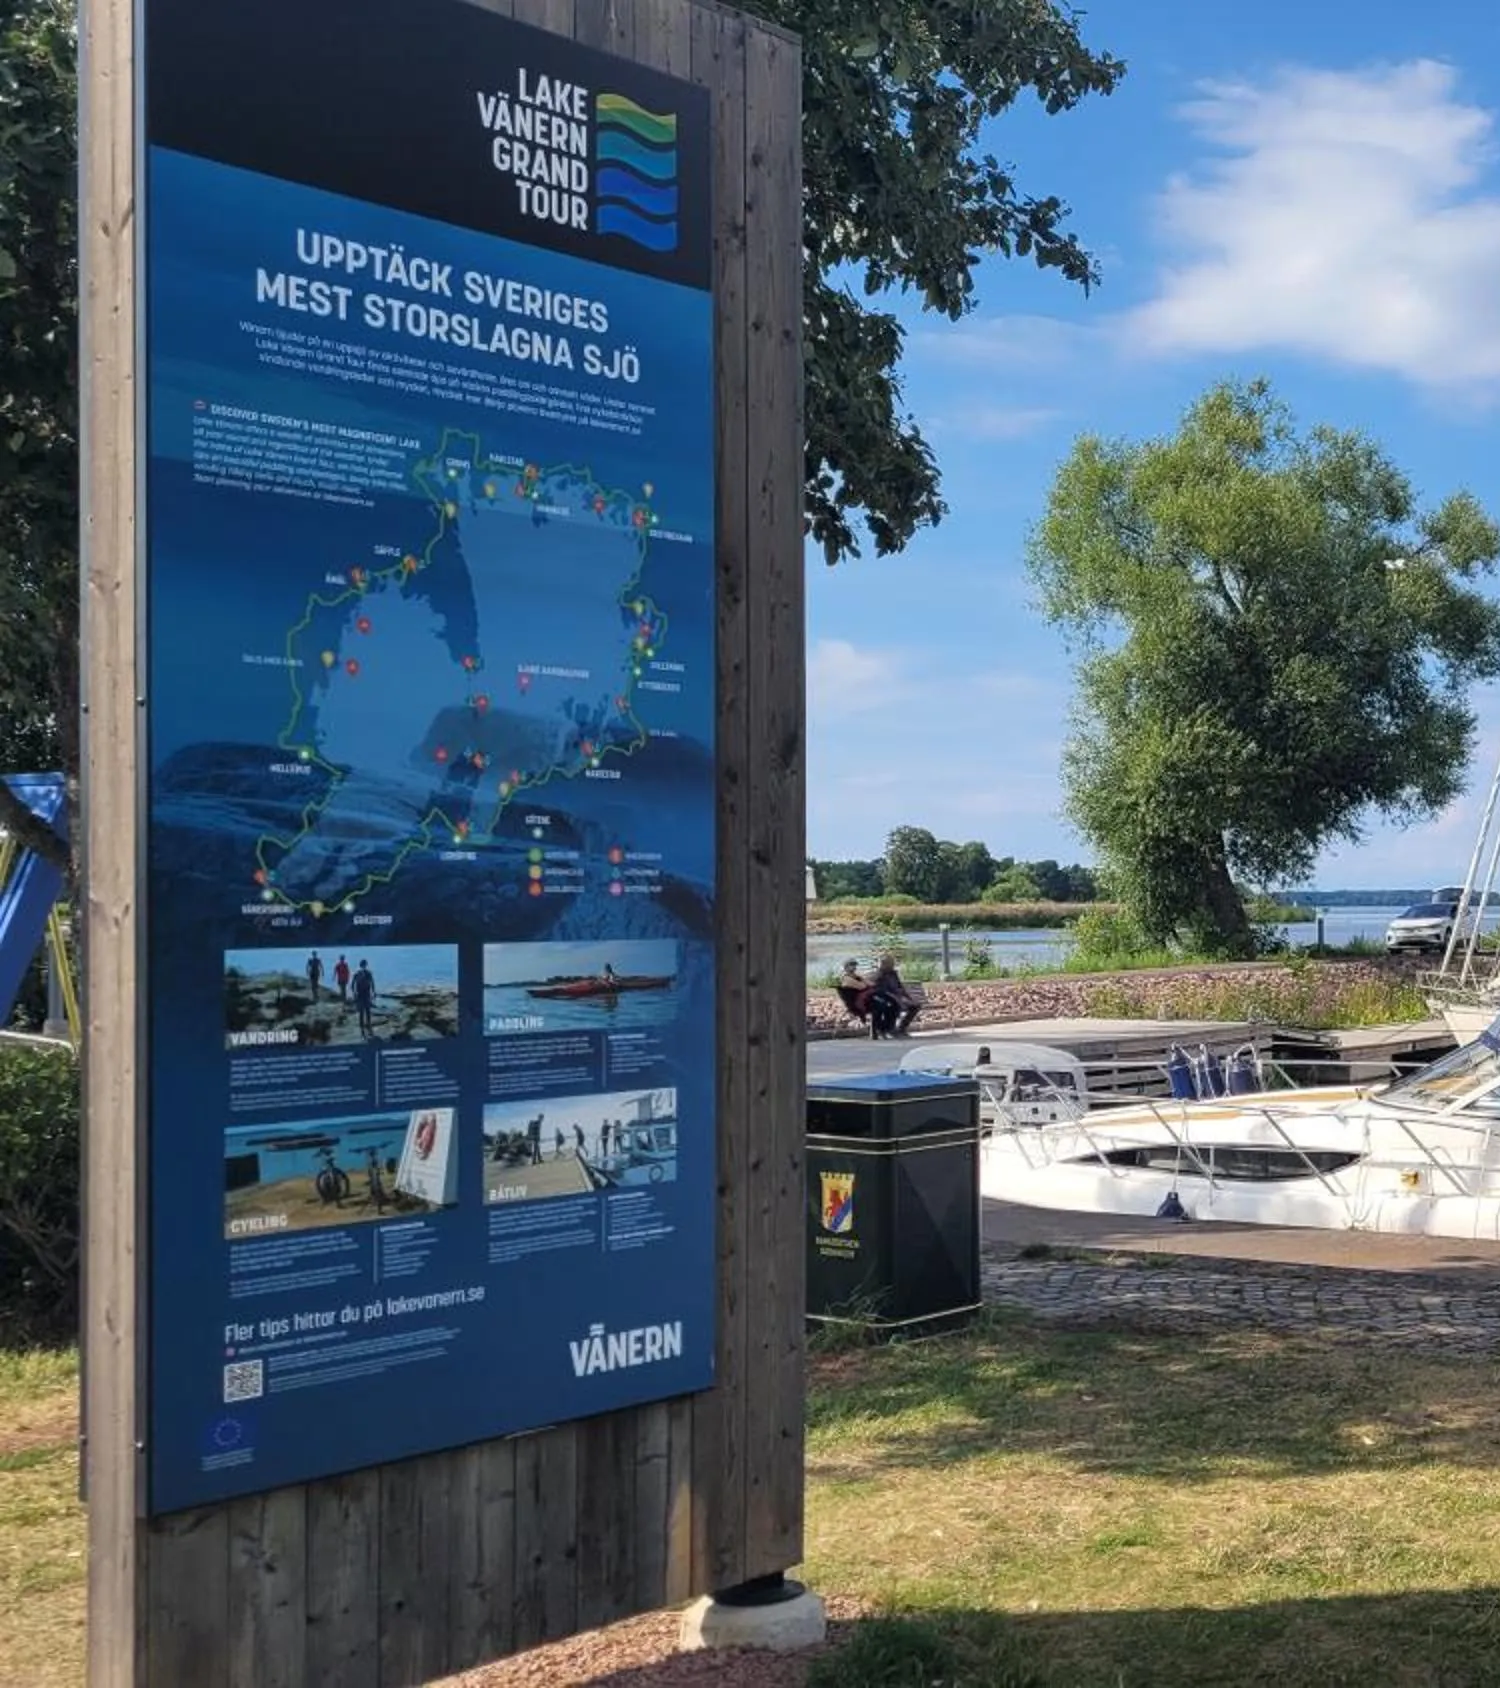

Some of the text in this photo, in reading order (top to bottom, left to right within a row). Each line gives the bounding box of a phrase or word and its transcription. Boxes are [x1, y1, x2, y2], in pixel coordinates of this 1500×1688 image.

[518, 67, 589, 122] LAKE
[477, 92, 588, 160] VÄNERN
[492, 135, 589, 194] GRAND
[516, 179, 589, 232] TOUR
[296, 228, 609, 334] UPPTÄCK SVERIGES
[256, 267, 641, 385] MEST STORSLAGNA SJÖ
[230, 1030, 299, 1045] VANDRING
[489, 1016, 544, 1030] PADDLING
[489, 1184, 528, 1201] BÅTLIV
[230, 1215, 288, 1233] CYKLING
[224, 1323, 256, 1344] Fler
[260, 1318, 289, 1340] tips
[294, 1312, 336, 1332] hittar
[340, 1306, 360, 1324] du
[364, 1302, 382, 1324] på
[386, 1284, 486, 1316] lakevanern.se
[569, 1323, 682, 1377] VÄNERN
